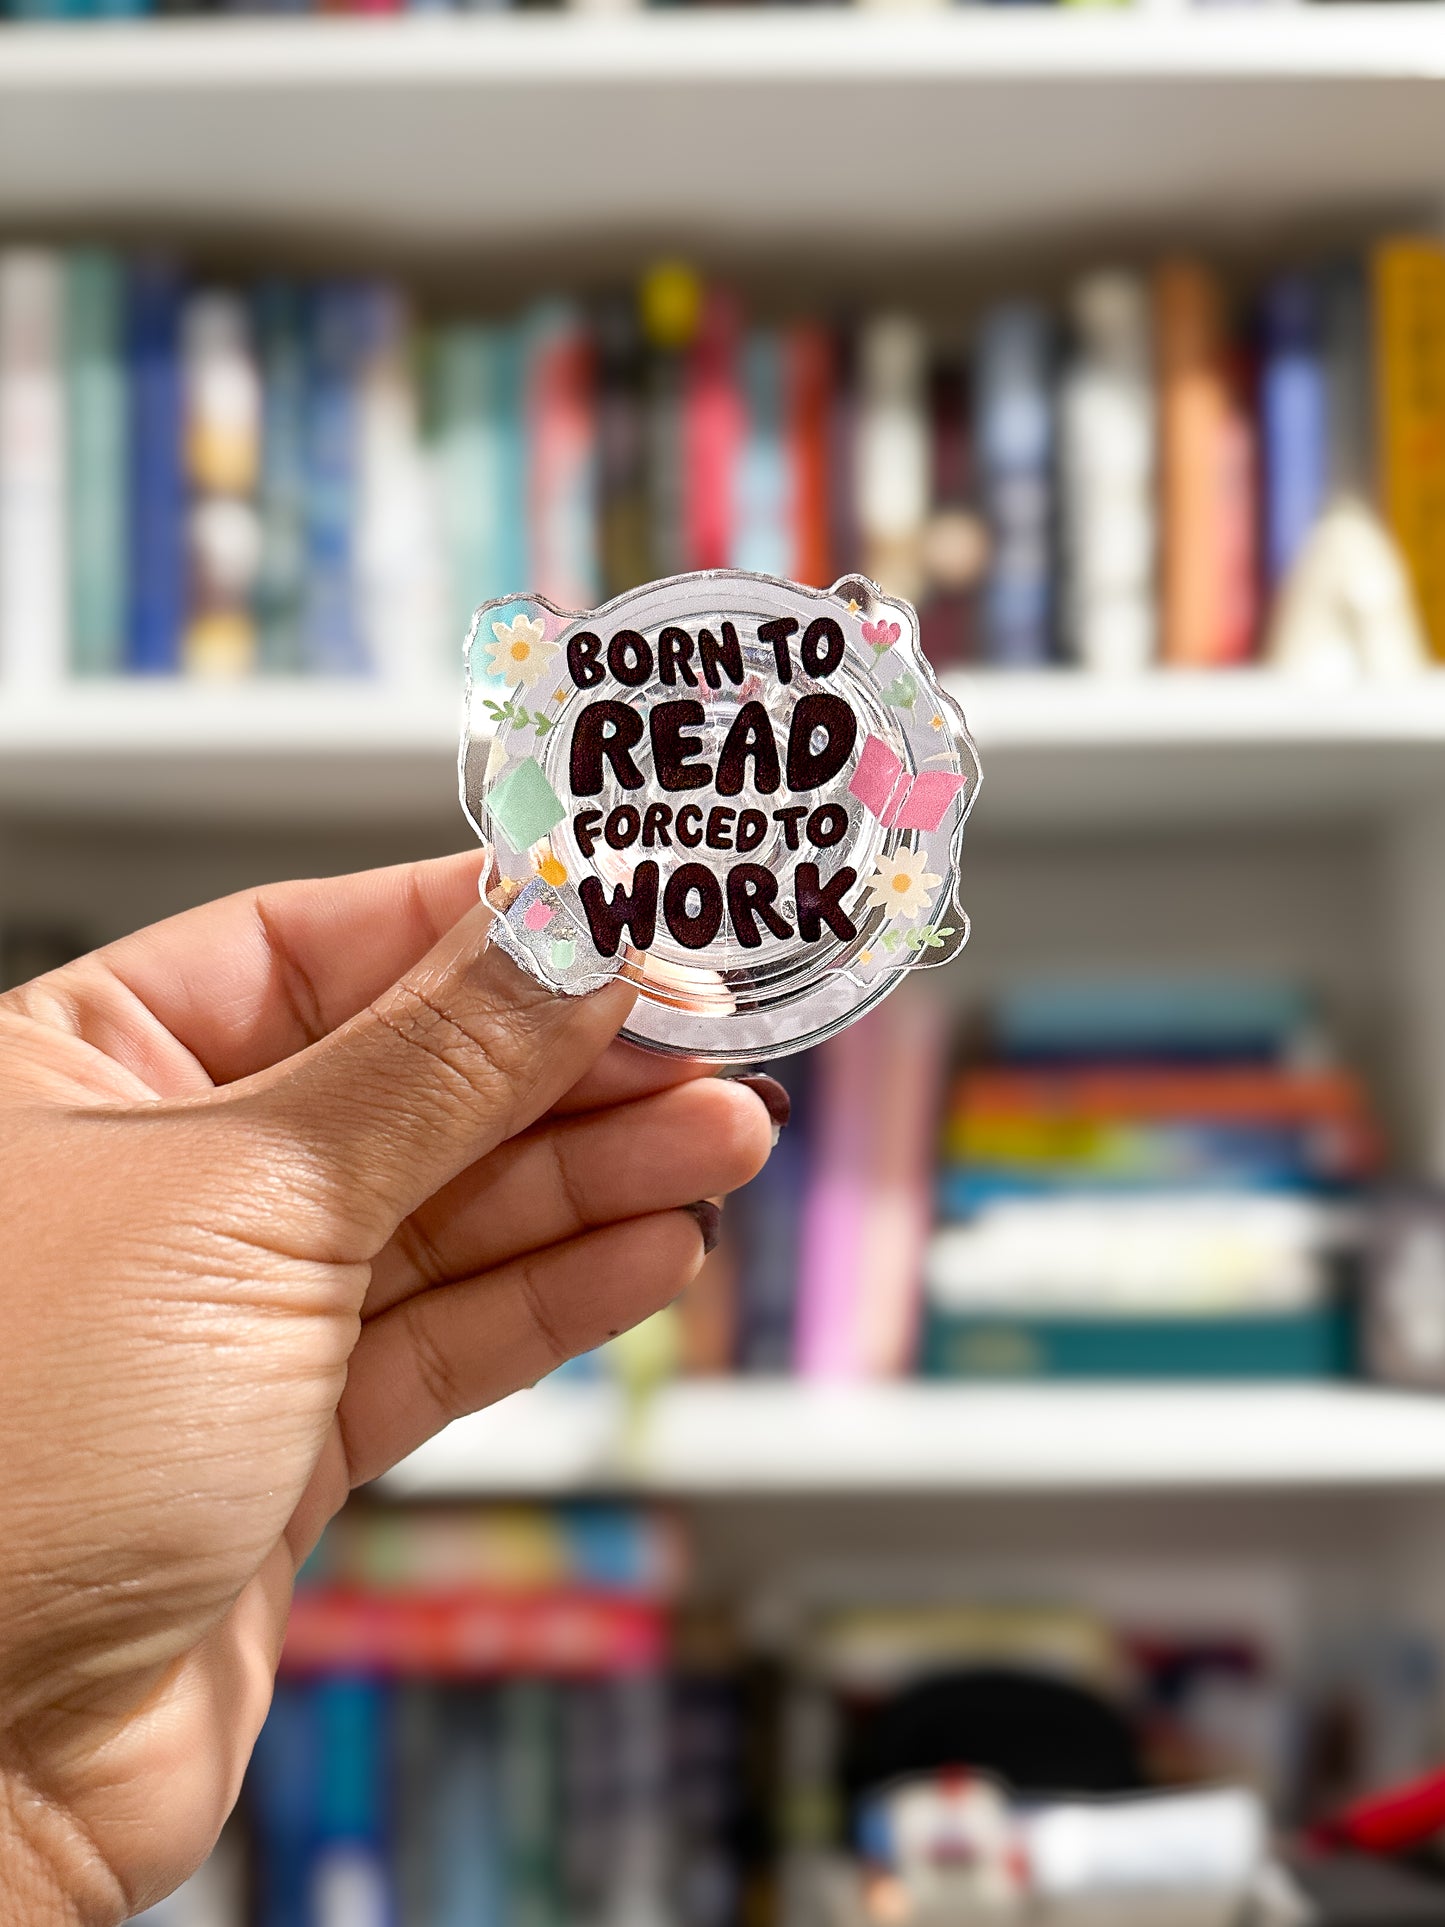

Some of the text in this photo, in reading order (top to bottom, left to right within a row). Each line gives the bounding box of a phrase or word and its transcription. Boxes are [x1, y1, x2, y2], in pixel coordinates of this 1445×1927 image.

[566, 616, 846, 691] BORN TO
[568, 691, 858, 798] READ
[572, 802, 849, 860] FORCED TO
[577, 859, 858, 959] WORK
